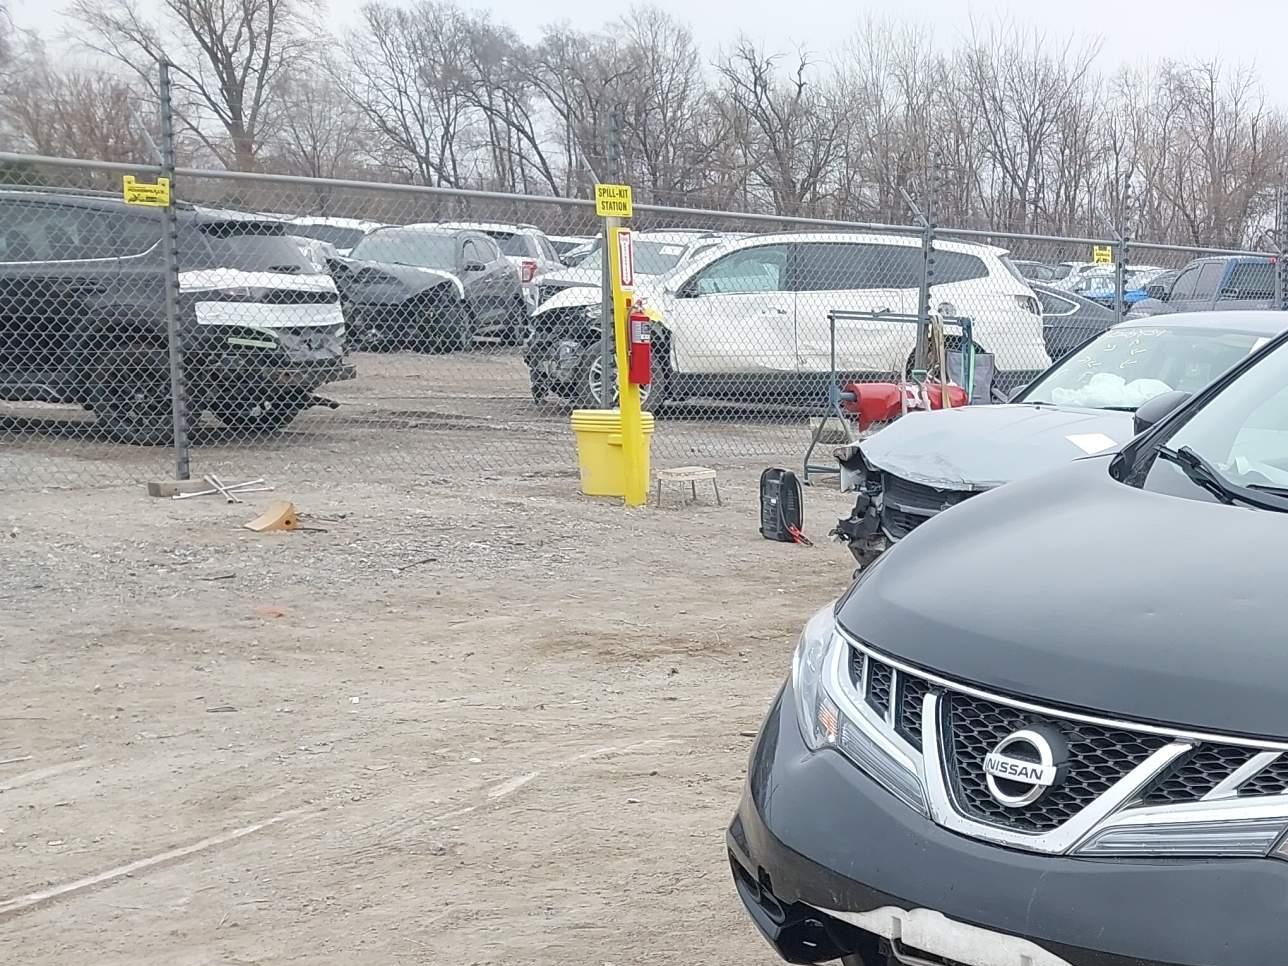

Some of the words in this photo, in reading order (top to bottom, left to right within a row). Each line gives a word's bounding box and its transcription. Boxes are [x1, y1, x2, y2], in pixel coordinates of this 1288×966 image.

[598, 187, 628, 199] SPILL-KIT
[601, 200, 628, 212] STATION
[986, 757, 1044, 780] NISSAN
